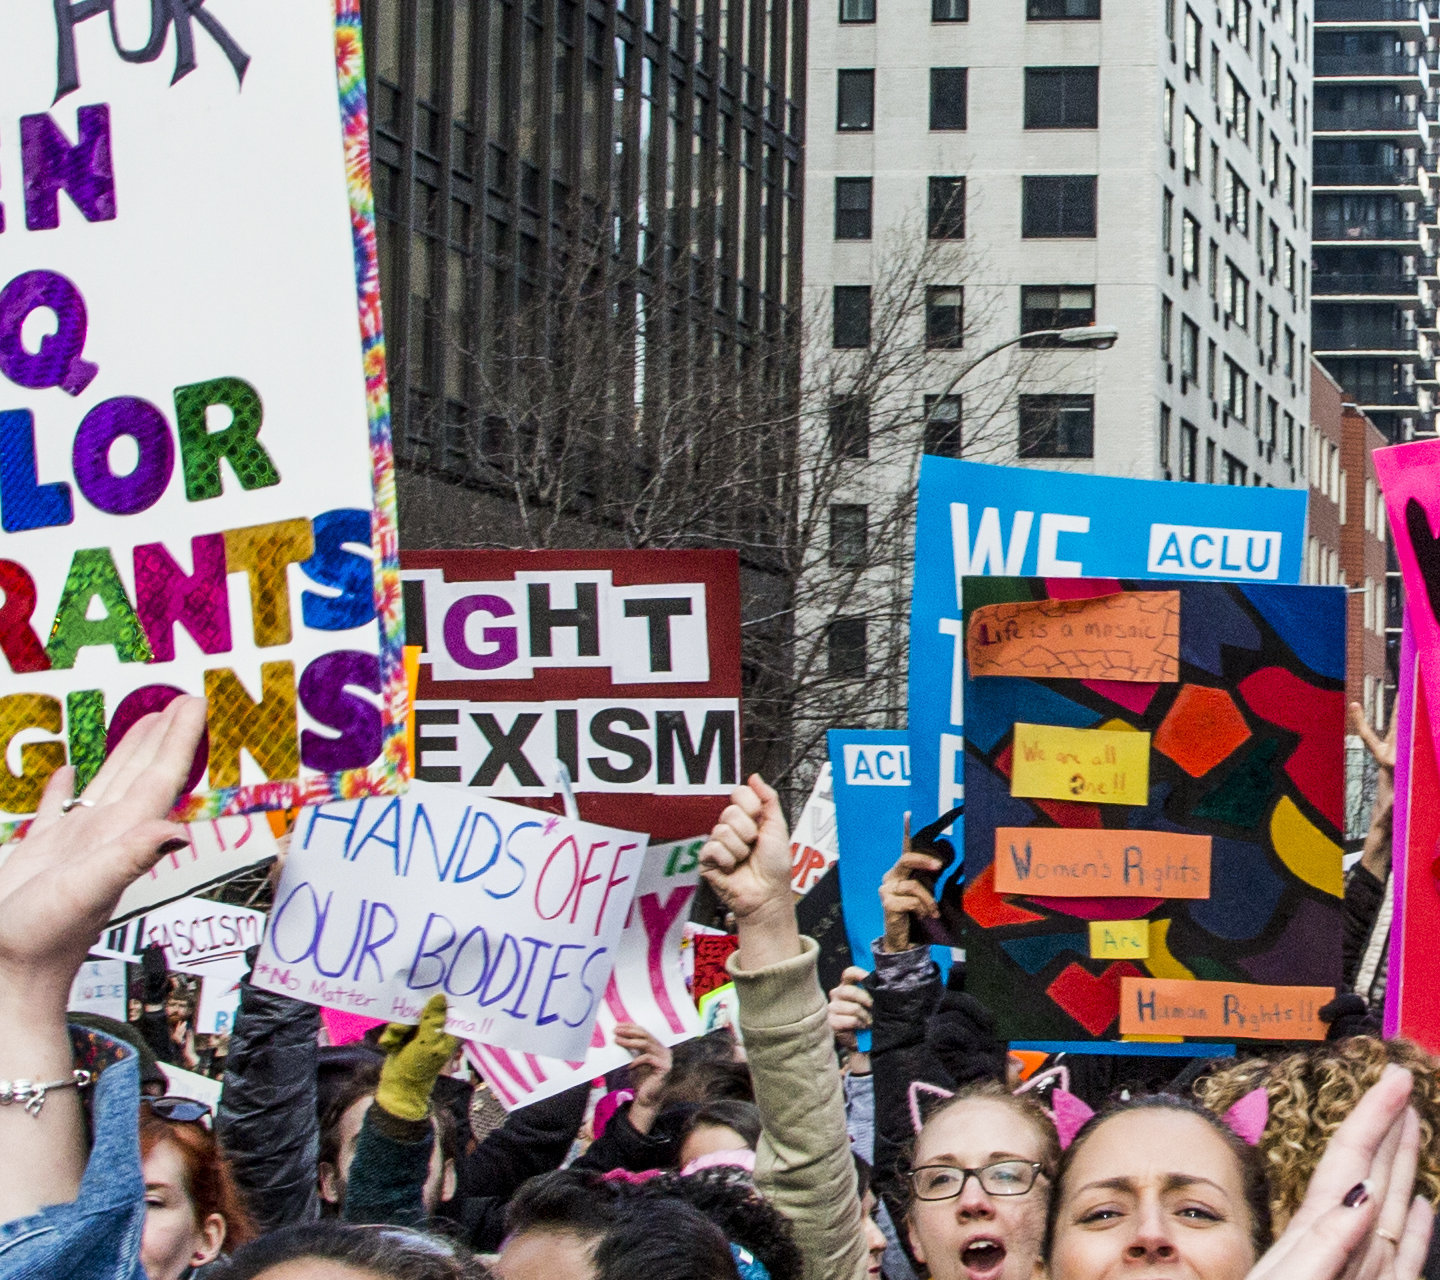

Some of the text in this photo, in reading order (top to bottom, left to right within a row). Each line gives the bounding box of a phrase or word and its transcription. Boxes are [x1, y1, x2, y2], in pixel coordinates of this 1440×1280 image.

[1157, 531, 1273, 572] ACLU
[414, 707, 737, 787] EXISM
[535, 835, 638, 936] OFF
[1011, 840, 1201, 892] Women's Rights
[272, 882, 398, 983] OUR
[407, 912, 607, 1028] BODIES
[1102, 928, 1142, 951] Are
[310, 979, 375, 1007] Matter
[1137, 988, 1208, 1022] Human
